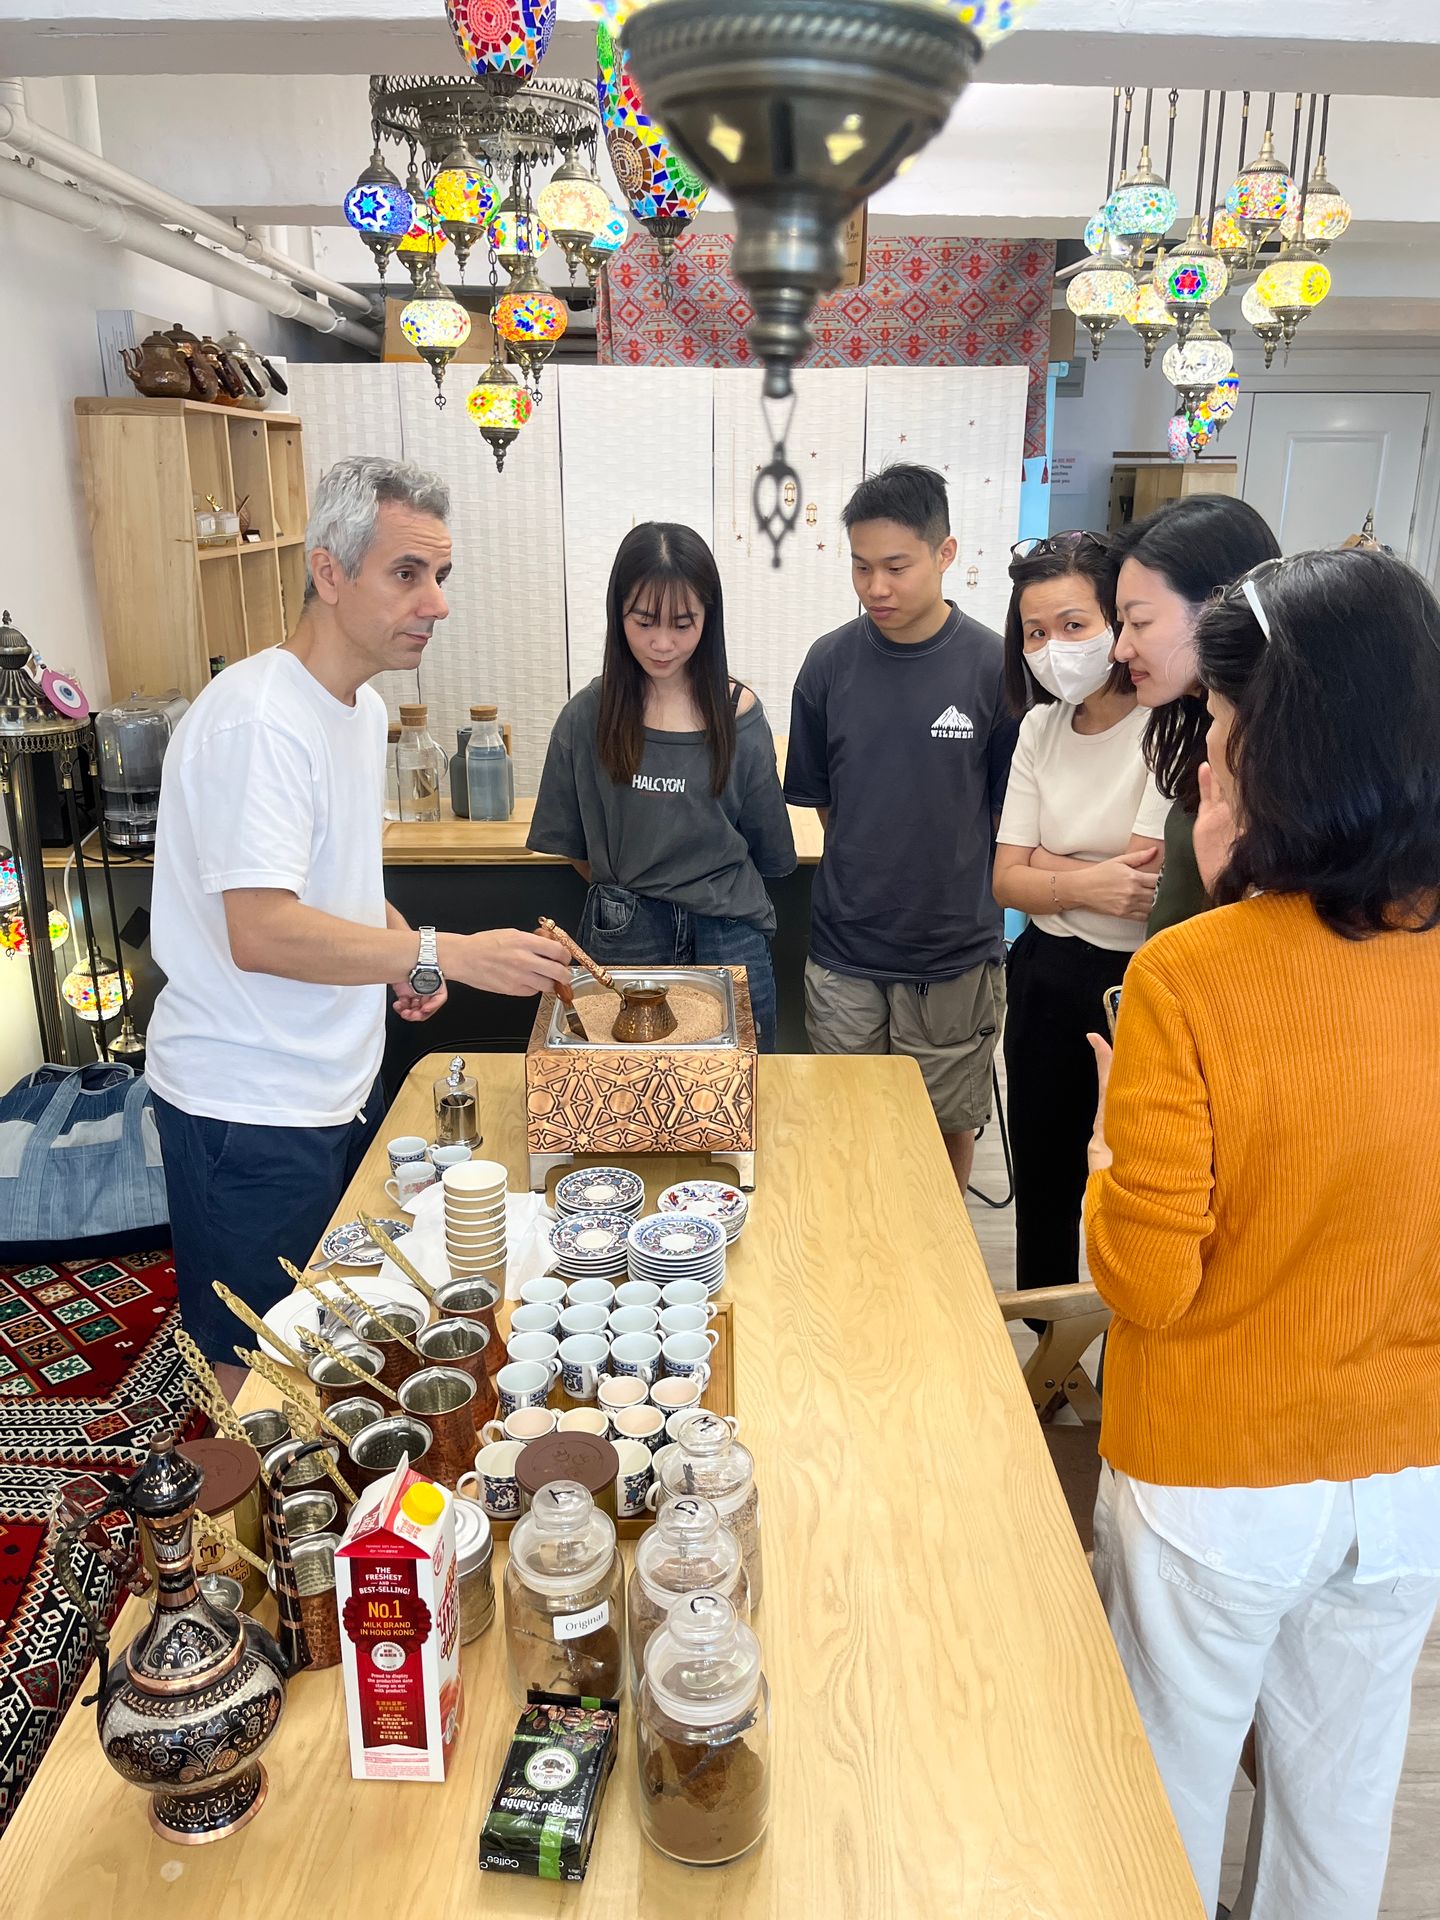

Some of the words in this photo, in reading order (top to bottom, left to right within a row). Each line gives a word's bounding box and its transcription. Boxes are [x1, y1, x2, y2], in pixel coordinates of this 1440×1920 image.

[632, 774, 686, 793] HALCYON
[375, 1566, 391, 1574] THE
[359, 1586, 411, 1595] BEST-SELLING!
[368, 1599, 402, 1619] No.1
[363, 1621, 382, 1629] MILK
[383, 1621, 411, 1629] BRAND
[565, 1610, 604, 1631] Original
[500, 1797, 540, 1812] Shahba
[541, 1800, 579, 1819] Aleppo
[486, 1855, 519, 1869] Coffee
